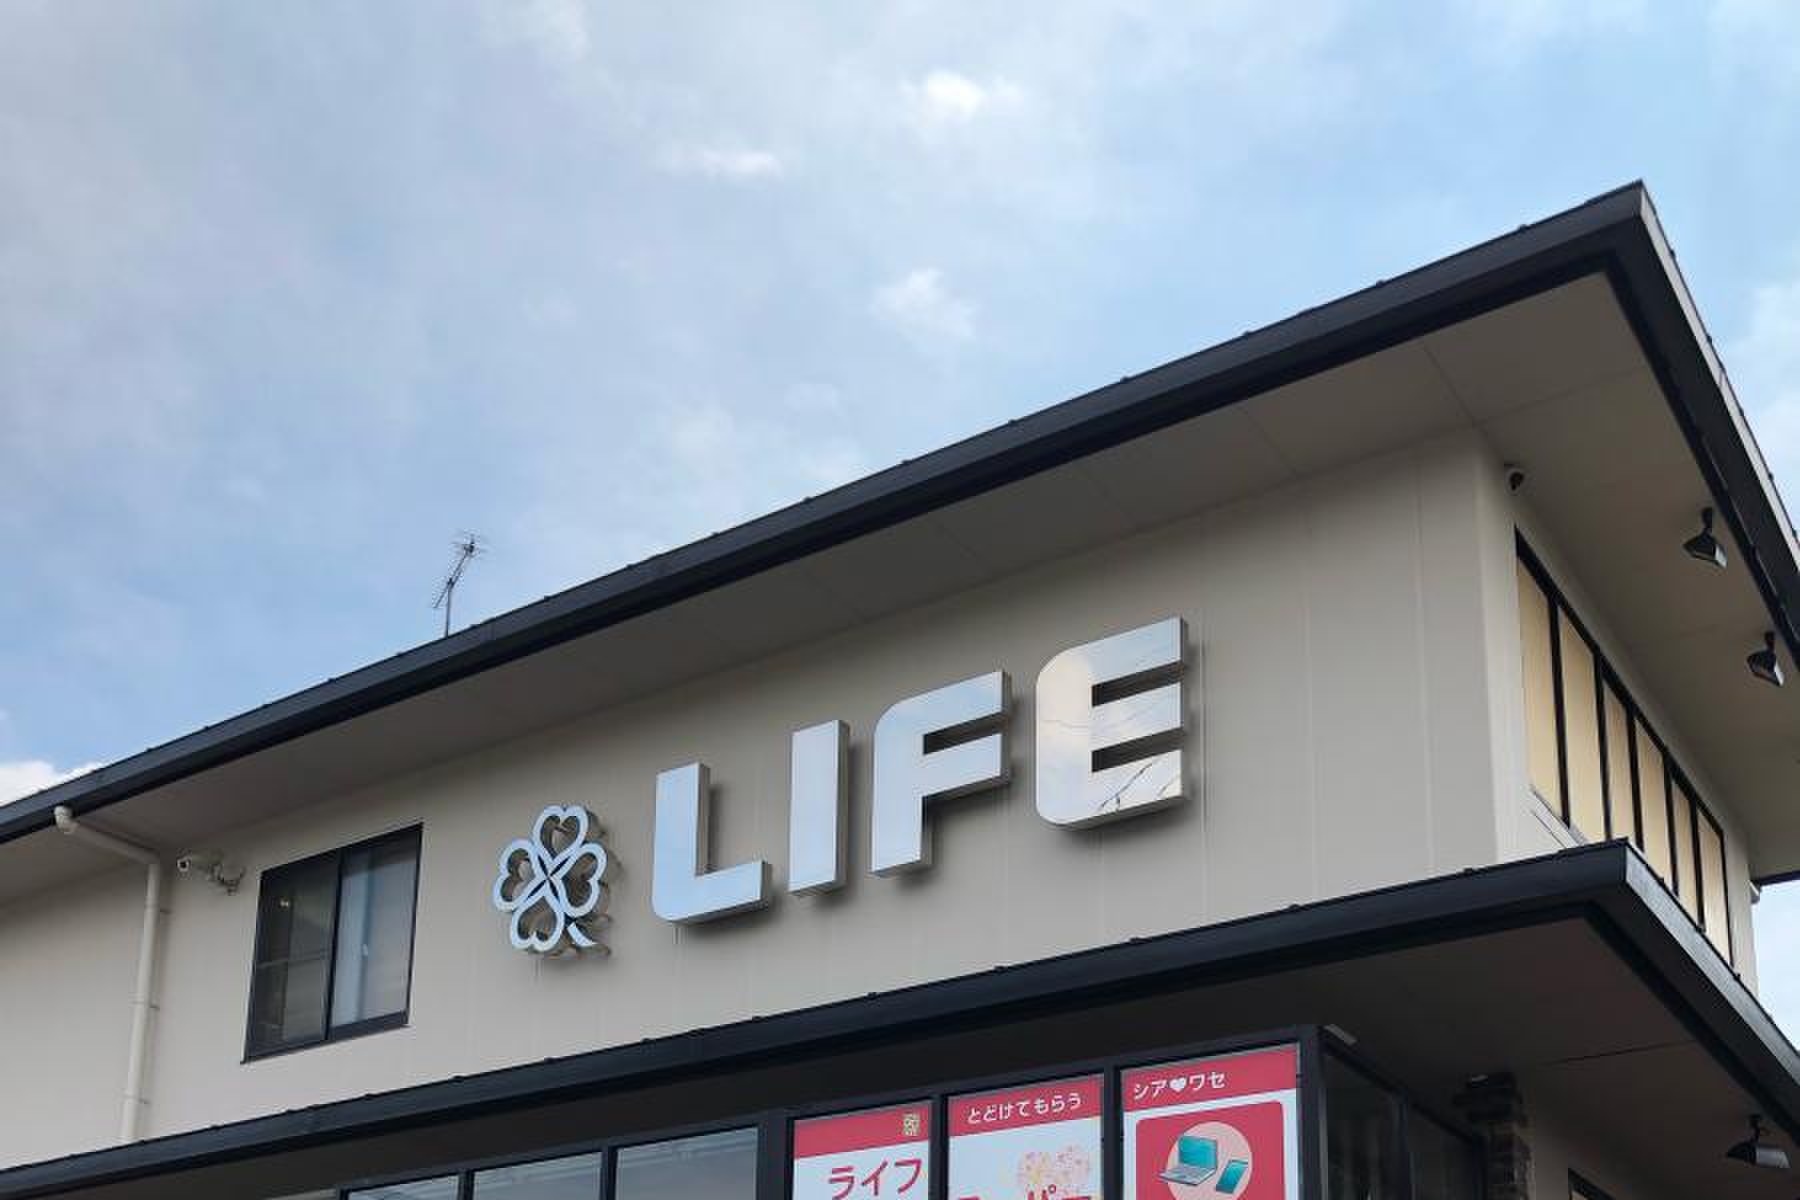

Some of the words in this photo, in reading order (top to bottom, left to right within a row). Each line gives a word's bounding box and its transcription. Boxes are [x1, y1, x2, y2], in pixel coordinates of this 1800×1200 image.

[651, 616, 1186, 925] LIFE
[966, 1092, 1083, 1125] とどけてもらう
